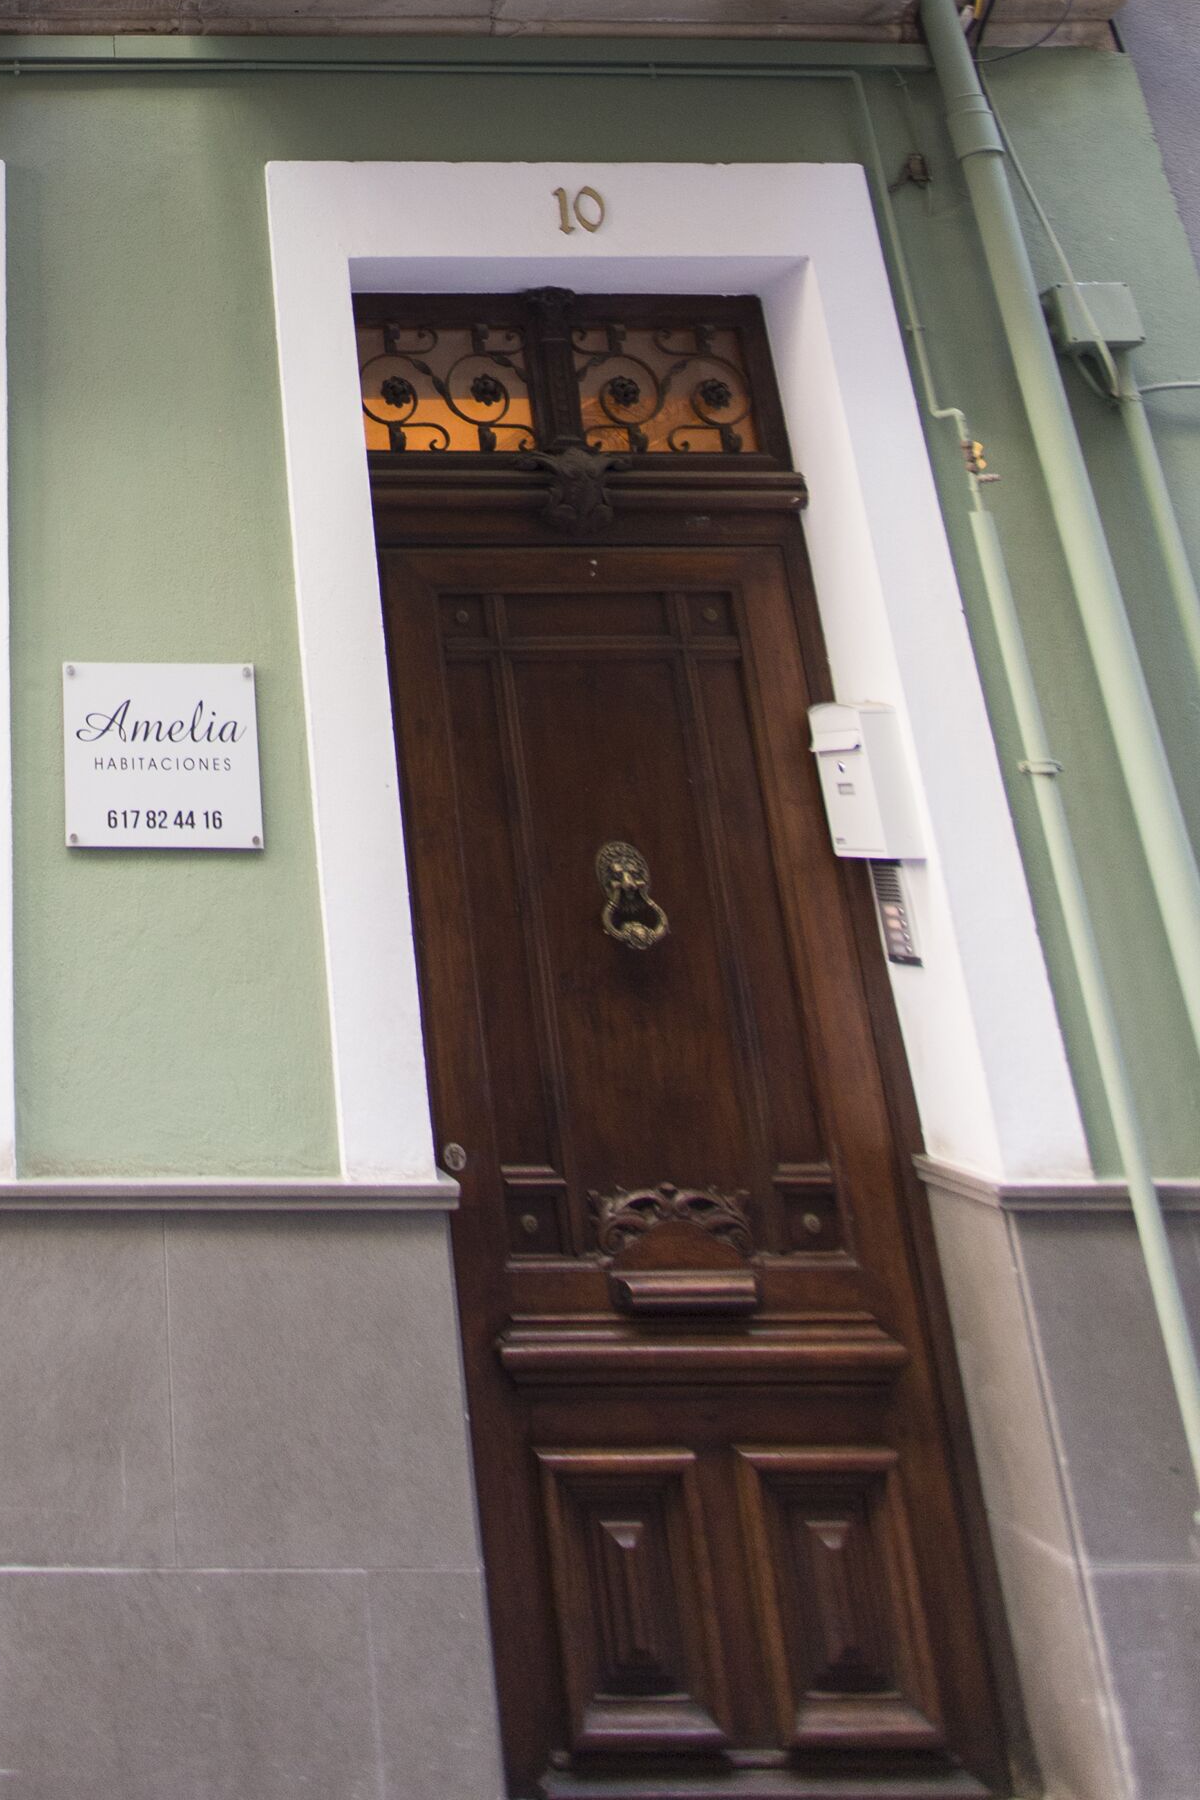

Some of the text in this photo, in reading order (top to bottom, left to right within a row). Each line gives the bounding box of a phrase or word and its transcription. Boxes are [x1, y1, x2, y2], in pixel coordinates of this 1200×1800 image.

[552, 186, 604, 234] 10
[76, 699, 247, 743] Amelia
[94, 757, 232, 771] HABITACIONES
[107, 810, 223, 829] 617 82 44 16
